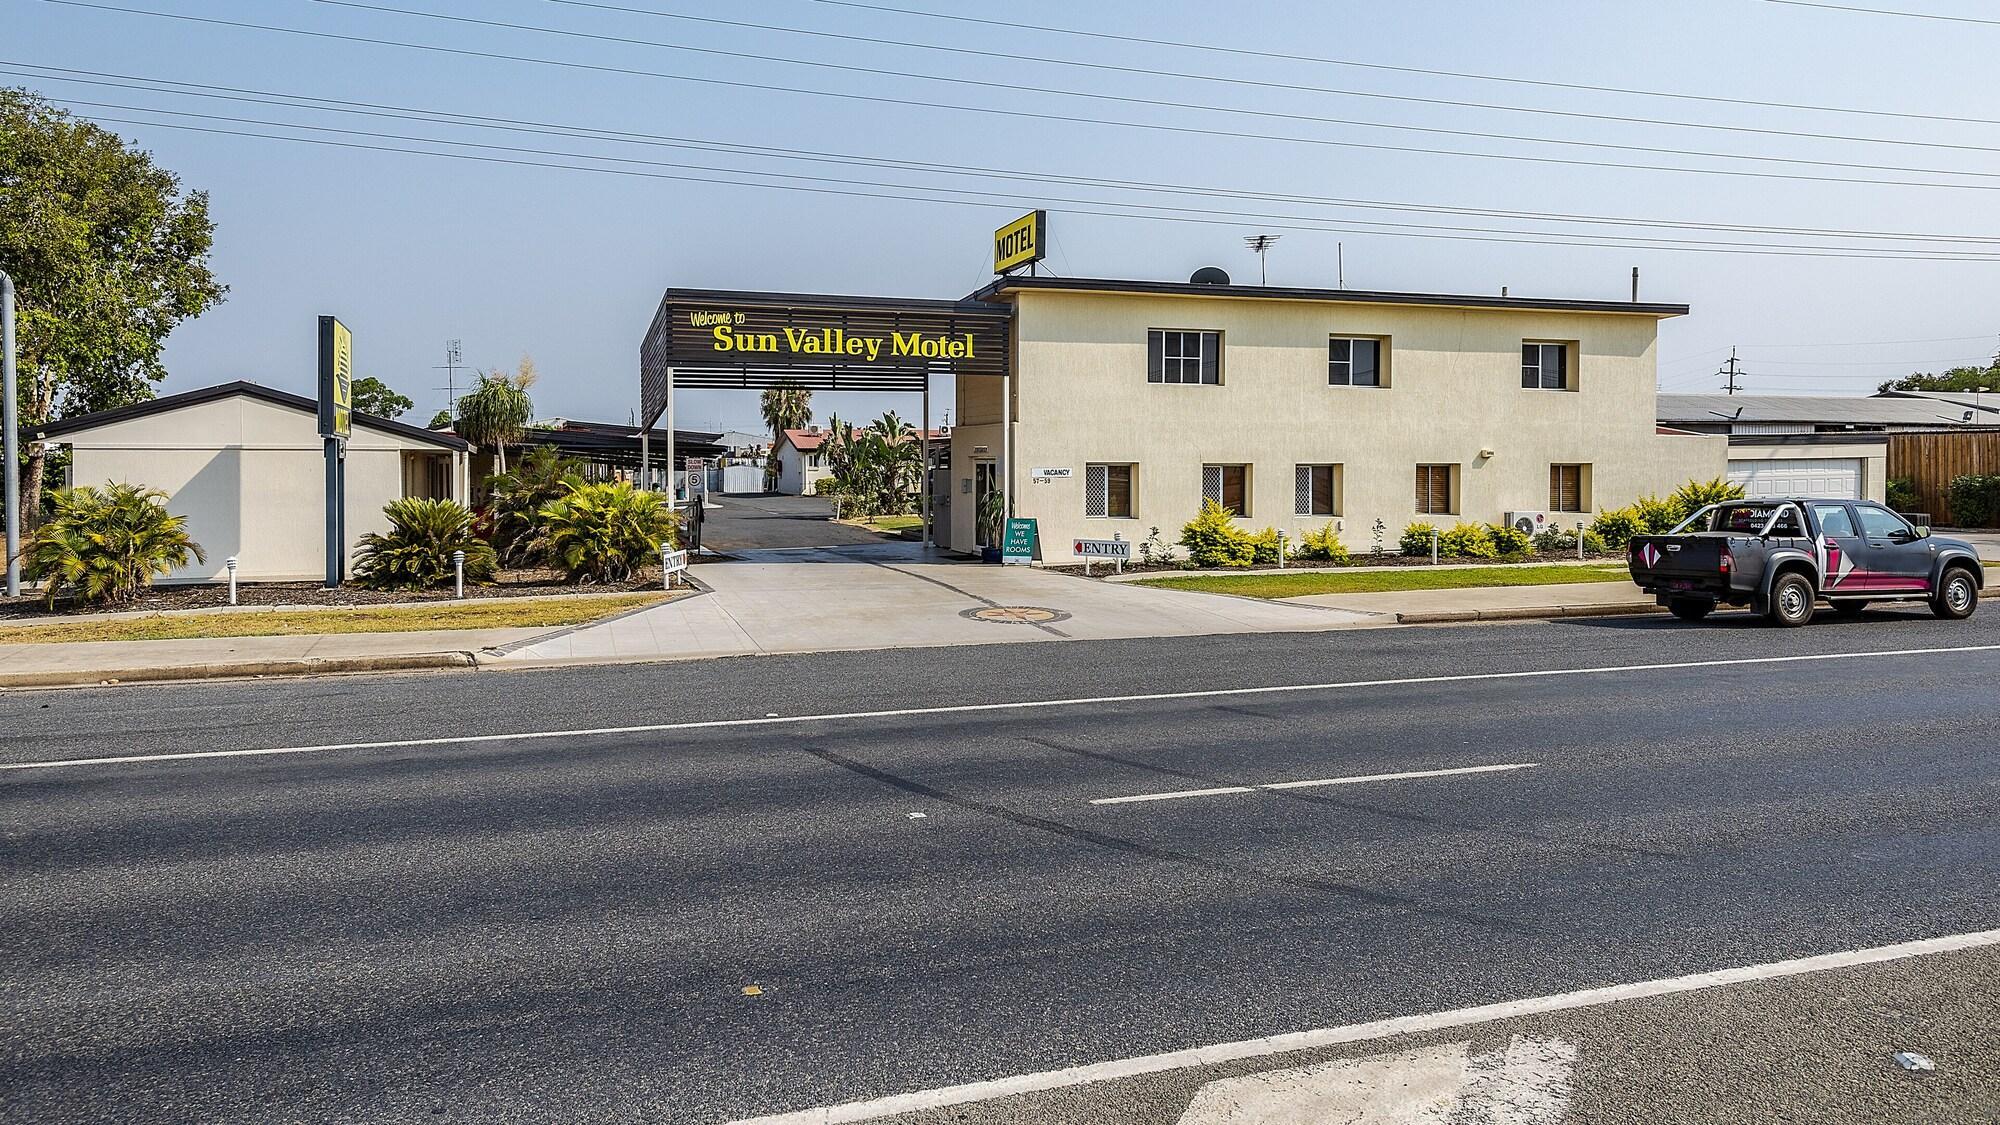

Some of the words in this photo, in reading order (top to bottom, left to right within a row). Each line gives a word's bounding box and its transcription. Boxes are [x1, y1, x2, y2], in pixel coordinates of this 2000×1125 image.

[996, 224, 1034, 263] MOTEL
[690, 312, 732, 327] Welcome
[734, 312, 746, 325] to
[713, 326, 779, 352] Sun
[782, 328, 883, 361] Valley
[890, 332, 975, 358] Motel
[1750, 509, 1789, 518] DIAMOD
[1083, 542, 1128, 555] ENTRY
[665, 553, 682, 569] ENTRY
